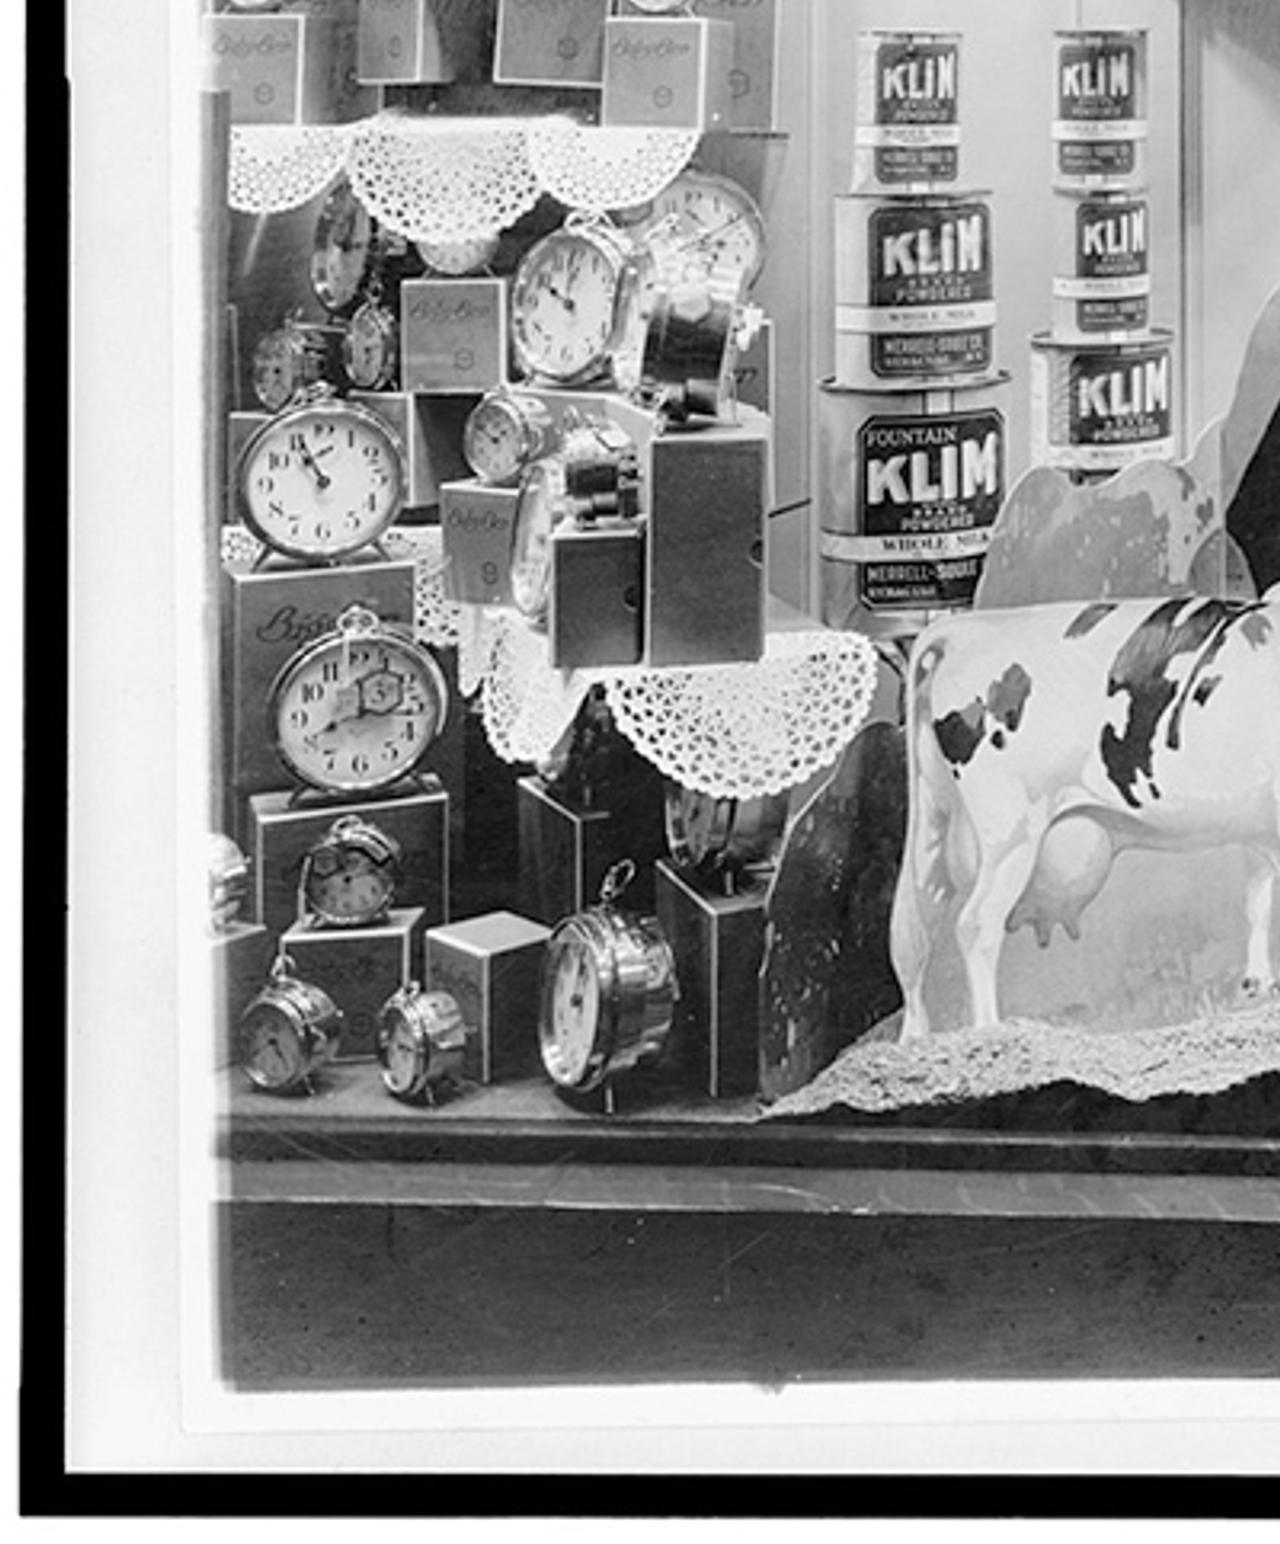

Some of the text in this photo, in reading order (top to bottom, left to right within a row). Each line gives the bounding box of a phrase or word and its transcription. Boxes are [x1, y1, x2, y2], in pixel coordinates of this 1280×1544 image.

[882, 53, 956, 100] KLIM
[1061, 52, 1129, 98] KLIM
[882, 214, 981, 277] KLIM
[1083, 208, 1146, 255] KLIM
[1077, 355, 1169, 420] KLIM
[866, 425, 959, 448] FOUNTAIN
[867, 429, 999, 506] KLIM
